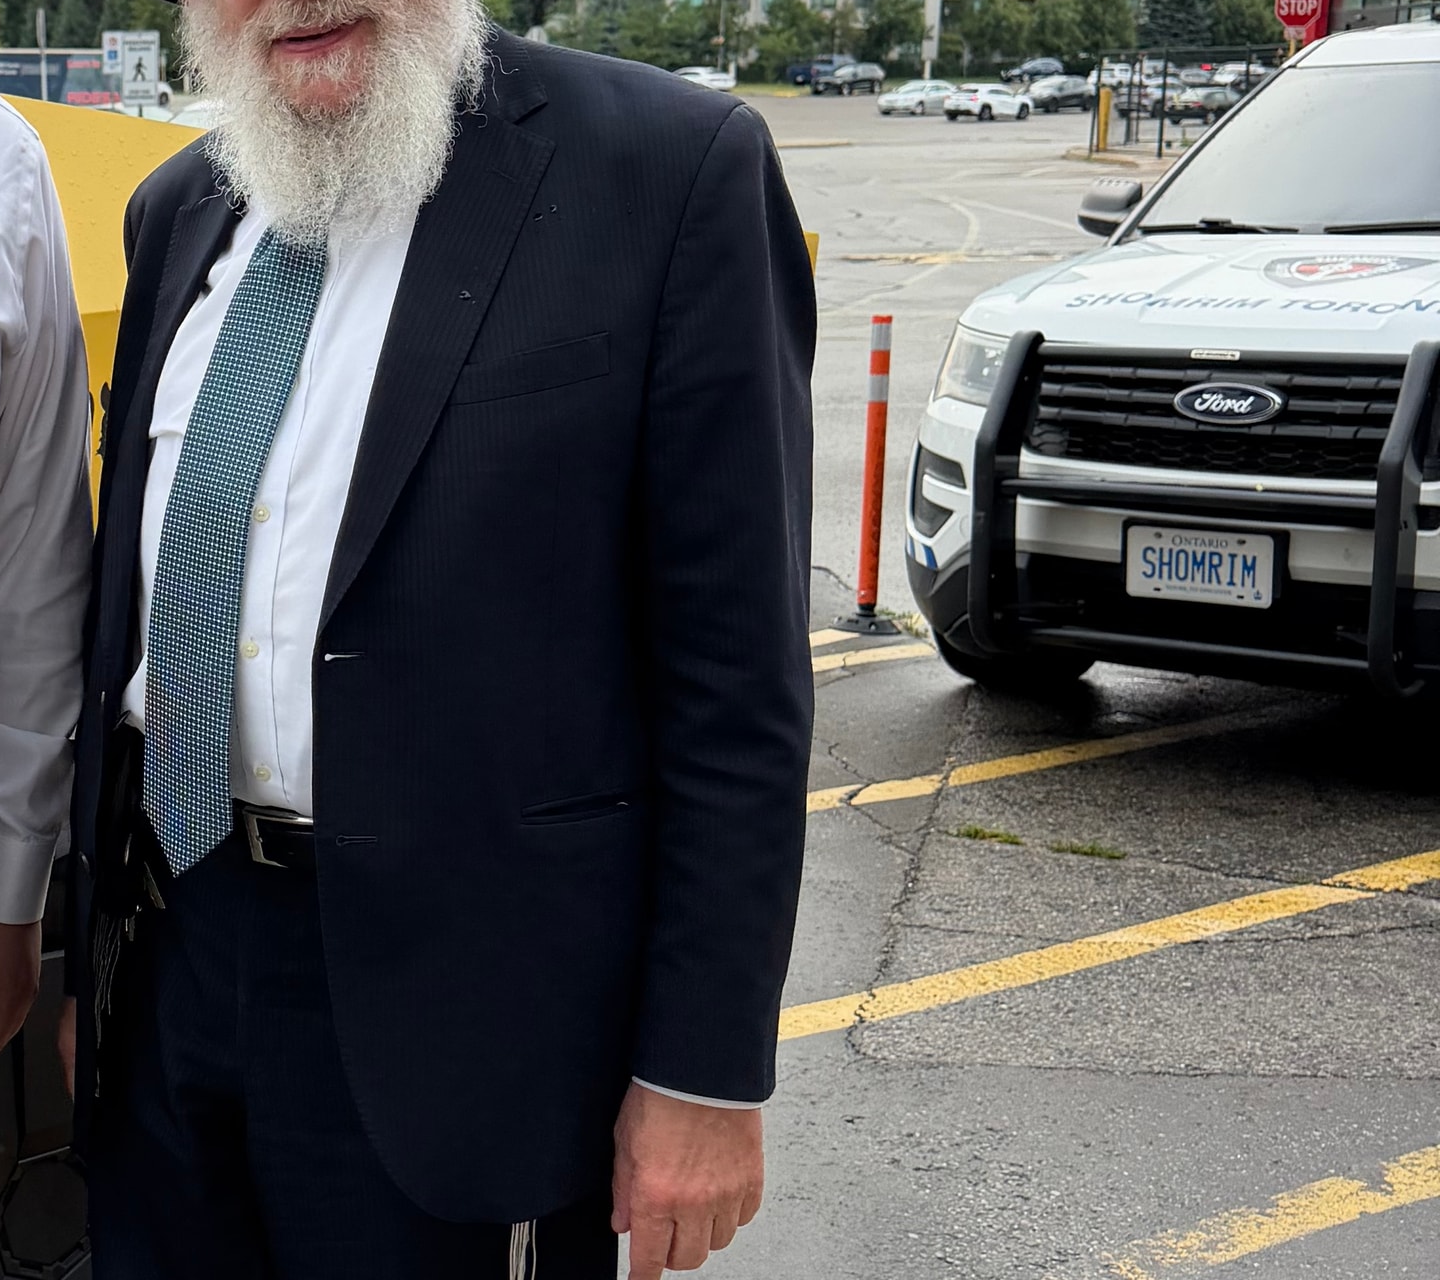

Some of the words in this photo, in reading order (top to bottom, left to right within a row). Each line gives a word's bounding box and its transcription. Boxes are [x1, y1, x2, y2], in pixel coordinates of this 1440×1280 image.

[1279, 298, 1440, 316] TORON
[1193, 391, 1256, 415] Ford
[1171, 533, 1229, 549] ONTARIO
[1141, 545, 1258, 589] SHOMRIM
